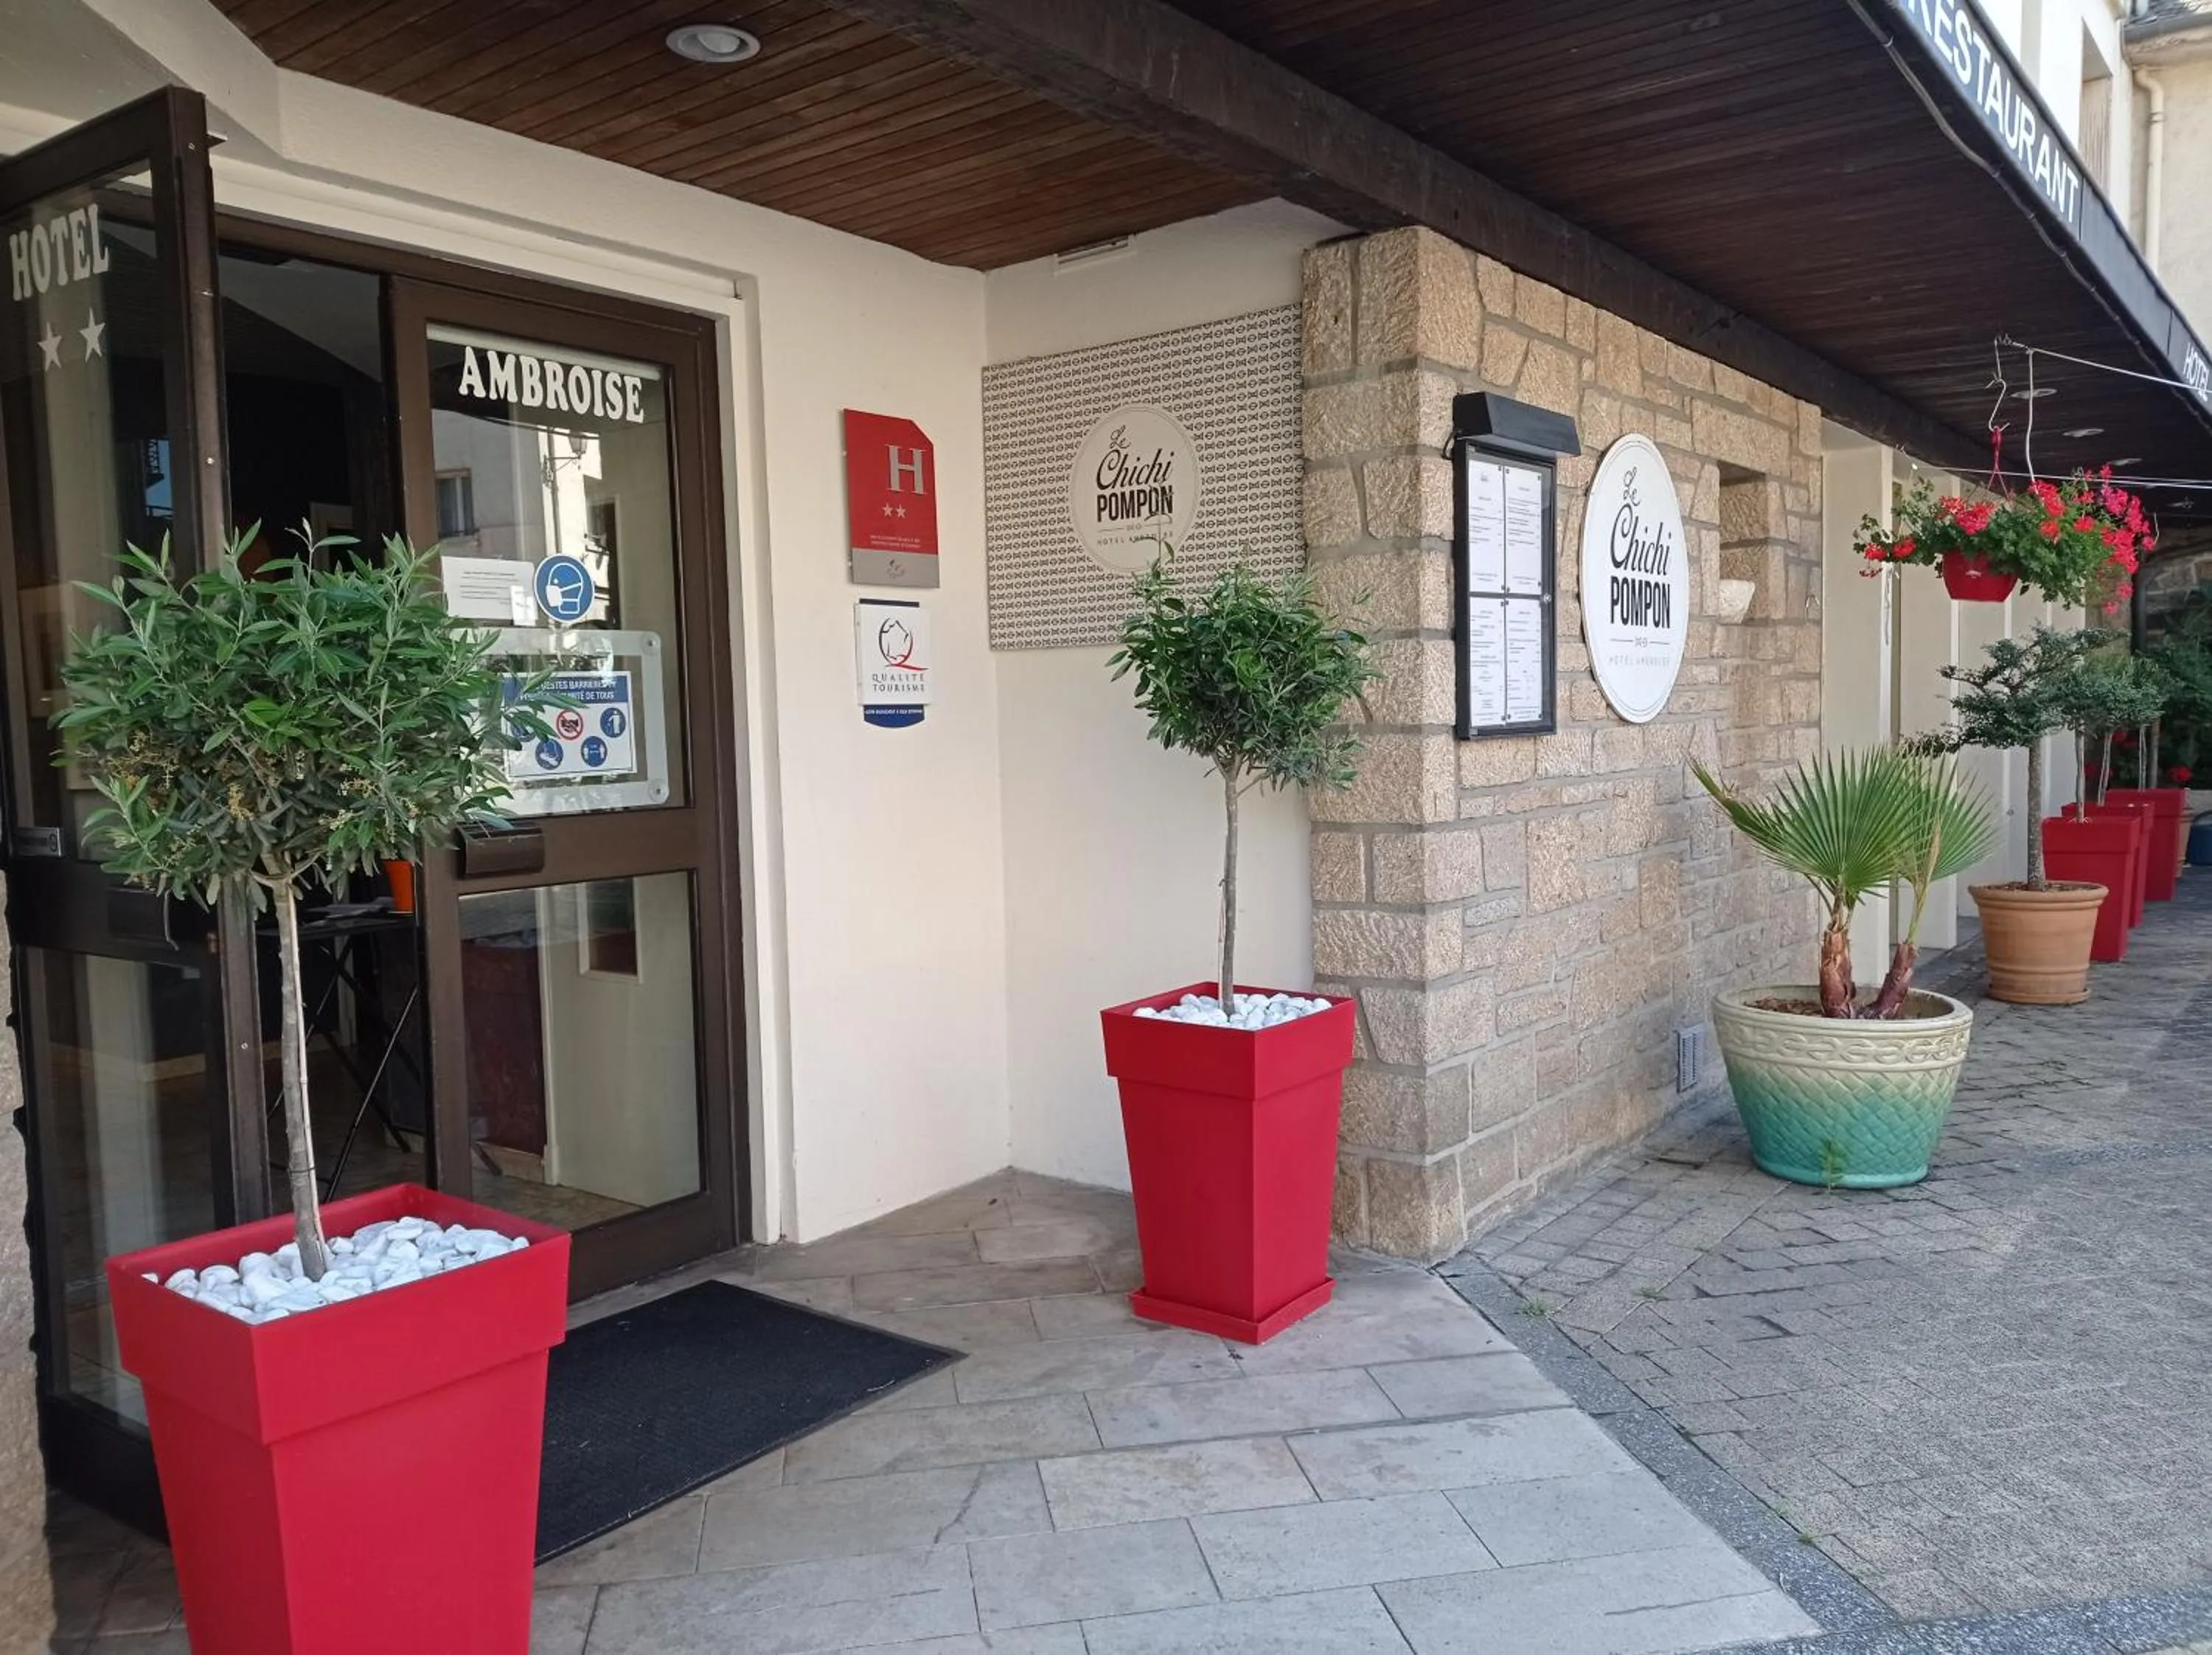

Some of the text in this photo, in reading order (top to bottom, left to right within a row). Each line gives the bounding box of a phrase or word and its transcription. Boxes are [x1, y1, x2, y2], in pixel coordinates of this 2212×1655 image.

[10, 203, 110, 301] HOTEL
[459, 346, 644, 423] AMBROISE
[1109, 424, 1131, 449] Le
[885, 443, 927, 495] H
[1096, 448, 1175, 490] Chichi
[1624, 466, 1641, 506] Le
[1096, 485, 1173, 522] POMPON
[1610, 503, 1672, 576] Chichi
[1610, 575, 1670, 628] POMPON
[873, 684, 925, 692] TOURISME
